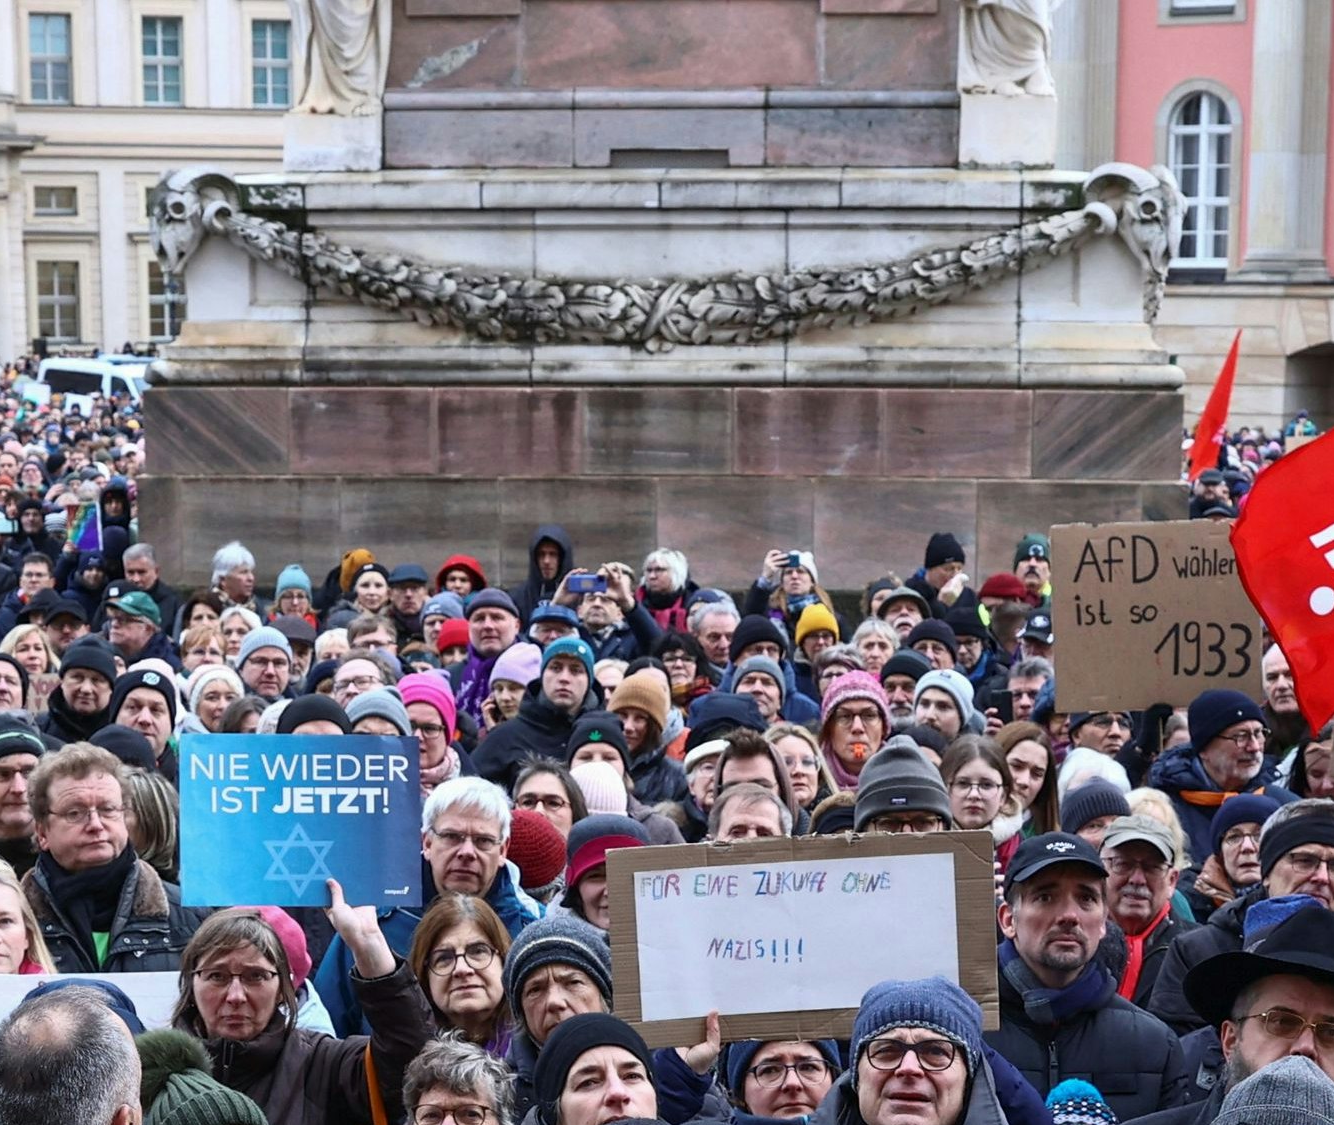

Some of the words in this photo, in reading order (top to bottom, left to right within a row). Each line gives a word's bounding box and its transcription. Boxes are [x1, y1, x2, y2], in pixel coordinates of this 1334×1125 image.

[1073, 535, 1159, 584] AfD
[1074, 594, 1112, 626] ist
[1130, 605, 1158, 624] so
[1154, 621, 1252, 678] 1933
[190, 753, 250, 781] NIE
[261, 753, 409, 782] WIEDER
[211, 786, 265, 814] IST
[272, 786, 390, 814] JETZT!
[693, 873, 739, 898] EINE
[841, 871, 892, 894] OHNE
[707, 936, 804, 964] NAZIS!!!
